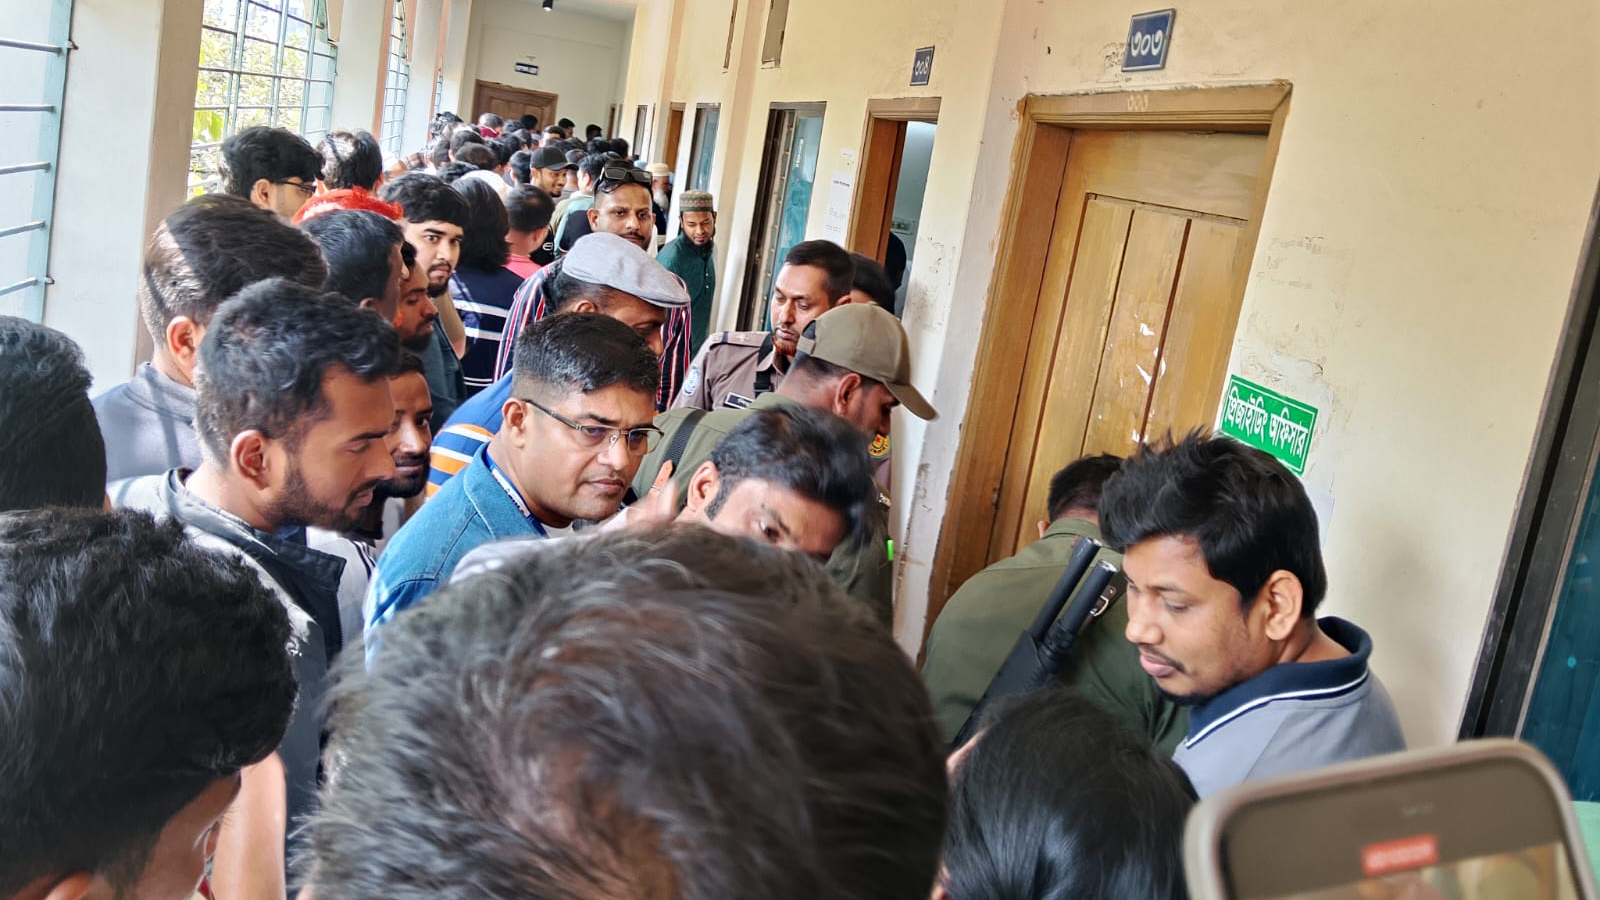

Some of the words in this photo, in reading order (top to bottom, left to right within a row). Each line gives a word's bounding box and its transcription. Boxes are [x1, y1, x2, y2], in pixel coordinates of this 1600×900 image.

[1130, 30, 1164, 57] ৩০৩
[1225, 386, 1268, 443] প্রিজাইডিং
[1269, 407, 1309, 458] অফিসার
